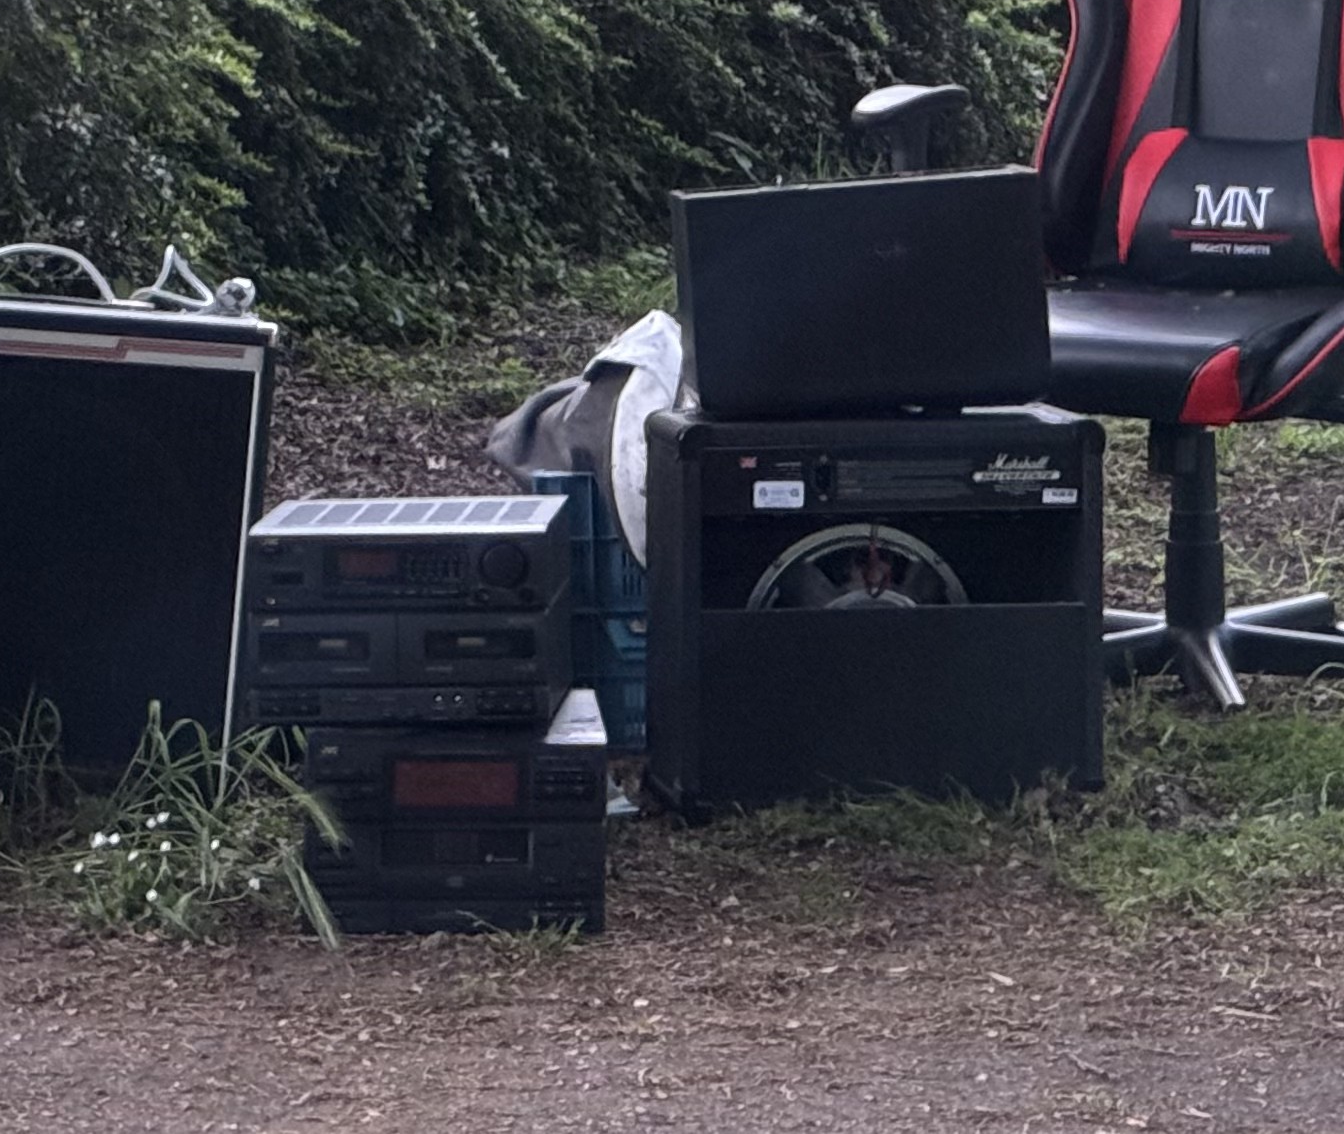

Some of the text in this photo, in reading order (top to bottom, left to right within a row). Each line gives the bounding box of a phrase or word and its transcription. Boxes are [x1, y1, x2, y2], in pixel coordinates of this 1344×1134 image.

[1191, 183, 1275, 230] MN
[1233, 243, 1271, 255] NORTH
[987, 452, 1051, 471] Marshall
